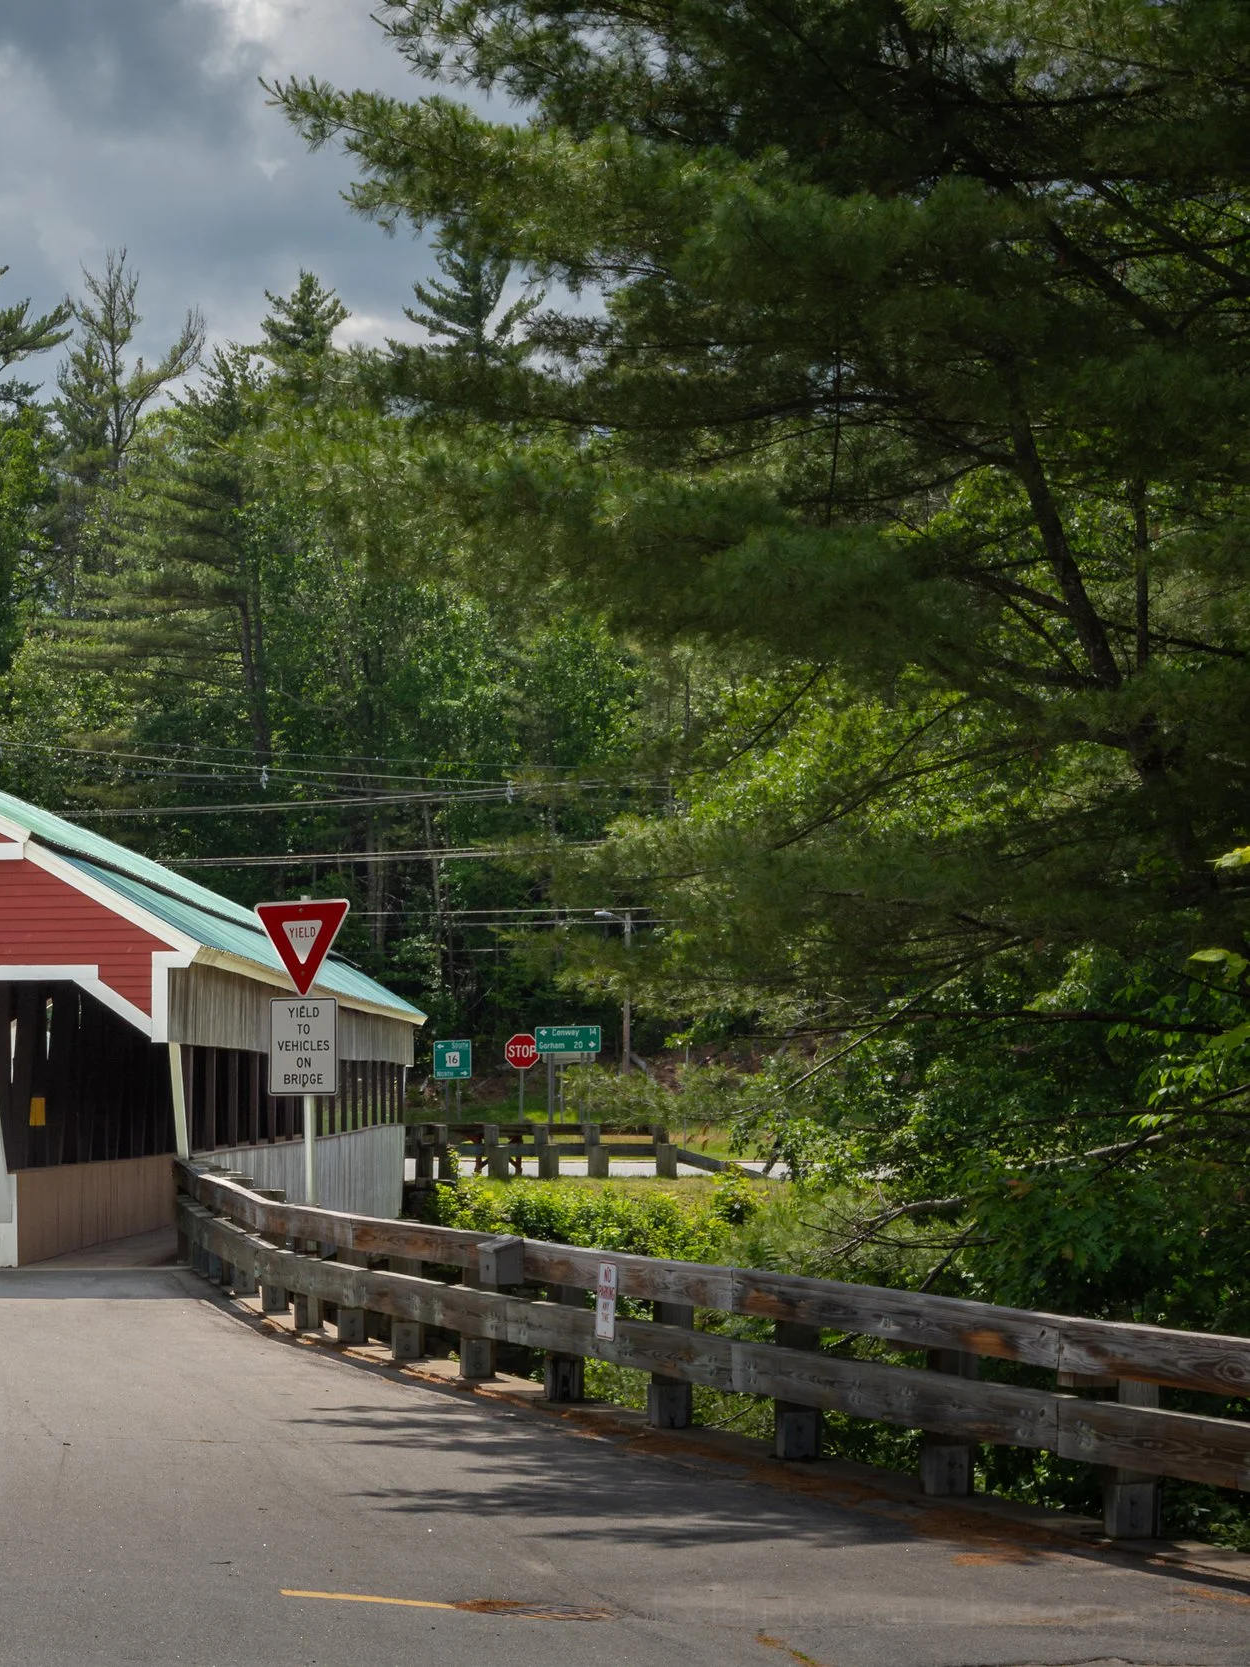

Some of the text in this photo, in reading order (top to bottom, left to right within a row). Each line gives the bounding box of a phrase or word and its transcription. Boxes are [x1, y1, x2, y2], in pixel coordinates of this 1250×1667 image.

[289, 926, 316, 938] YIELD
[288, 1006, 320, 1018] YIELD
[297, 1023, 311, 1035] TO
[551, 1028, 597, 1037] Conway 14
[277, 1040, 330, 1051] VEHICLES
[574, 1041, 584, 1049] 20
[507, 1045, 536, 1058] STOP
[296, 1057, 312, 1068] ON
[448, 1055, 459, 1064] 16
[283, 1073, 324, 1085] BRIDGE
